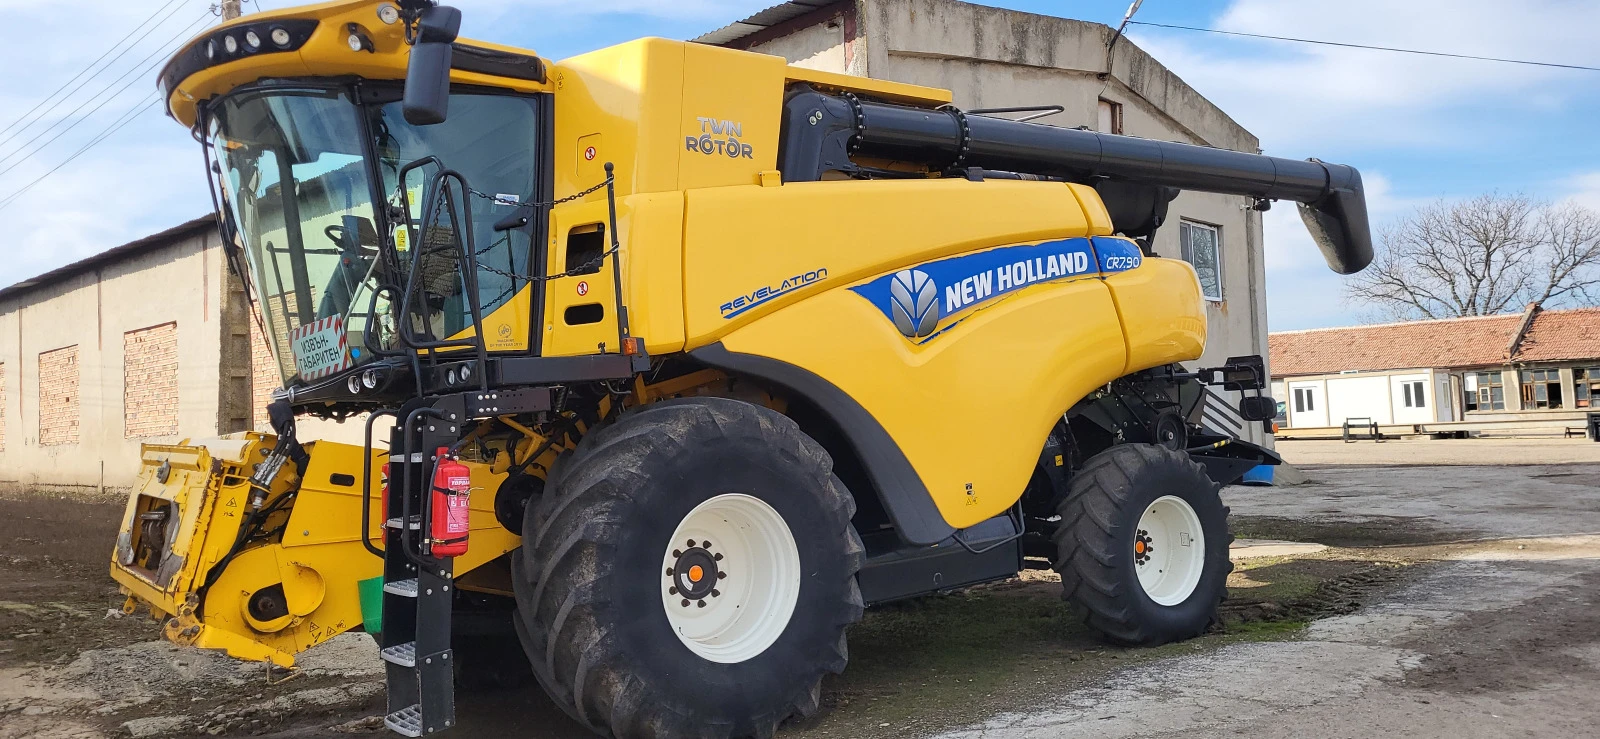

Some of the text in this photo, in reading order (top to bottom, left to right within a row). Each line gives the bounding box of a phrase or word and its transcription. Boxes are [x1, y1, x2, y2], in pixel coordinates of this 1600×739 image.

[697, 116, 743, 138] TWIN
[685, 133, 754, 160] ROTOR
[1106, 256, 1141, 270] CR7.90
[719, 267, 828, 315] REVELATION
[945, 251, 1089, 313] NEW HOLLAND
[300, 334, 329, 354] ИЗВЪН-
[298, 346, 341, 371] ГАБАРИТЕН
